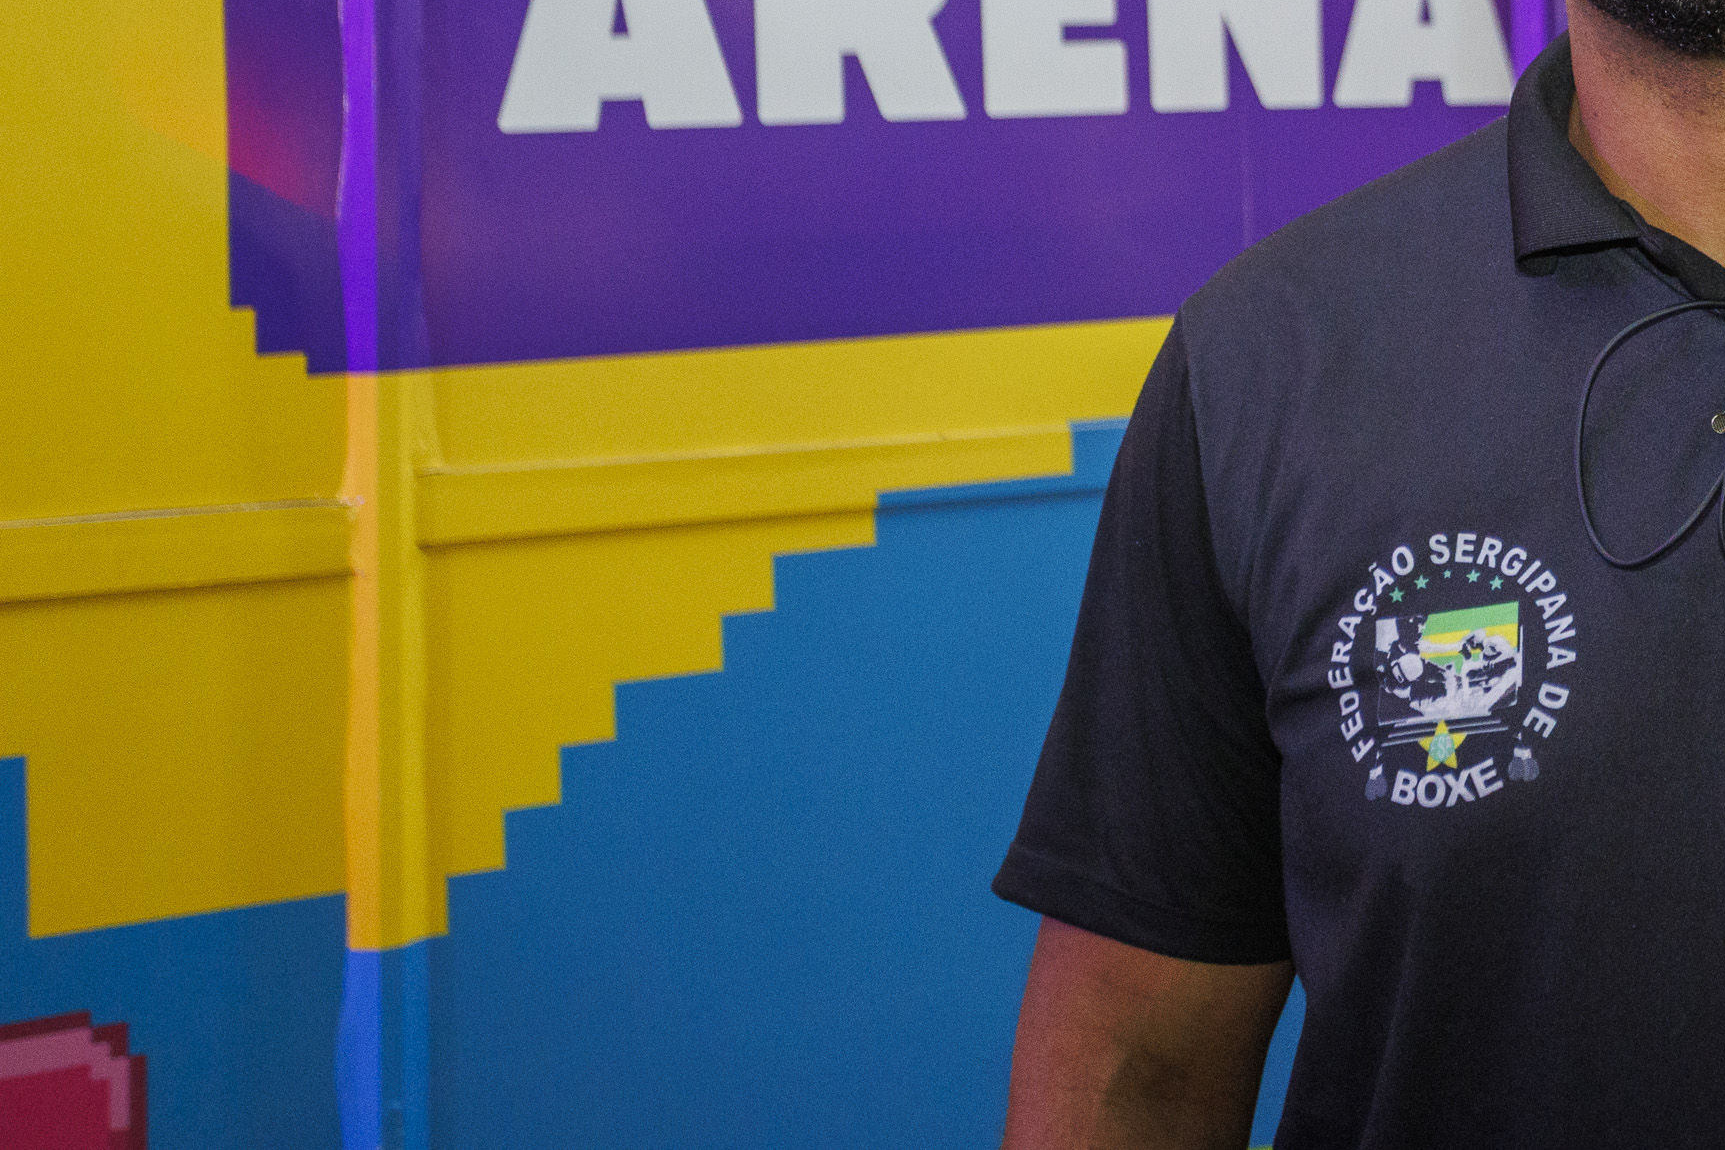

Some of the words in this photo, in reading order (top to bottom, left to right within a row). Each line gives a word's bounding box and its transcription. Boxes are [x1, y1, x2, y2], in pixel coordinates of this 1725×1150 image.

[1327, 545, 1415, 762] FEDERAÇÃO
[1428, 532, 1577, 670] SERGIPANA
[1522, 682, 1570, 738] DE
[1391, 758, 1504, 807] BOXE
